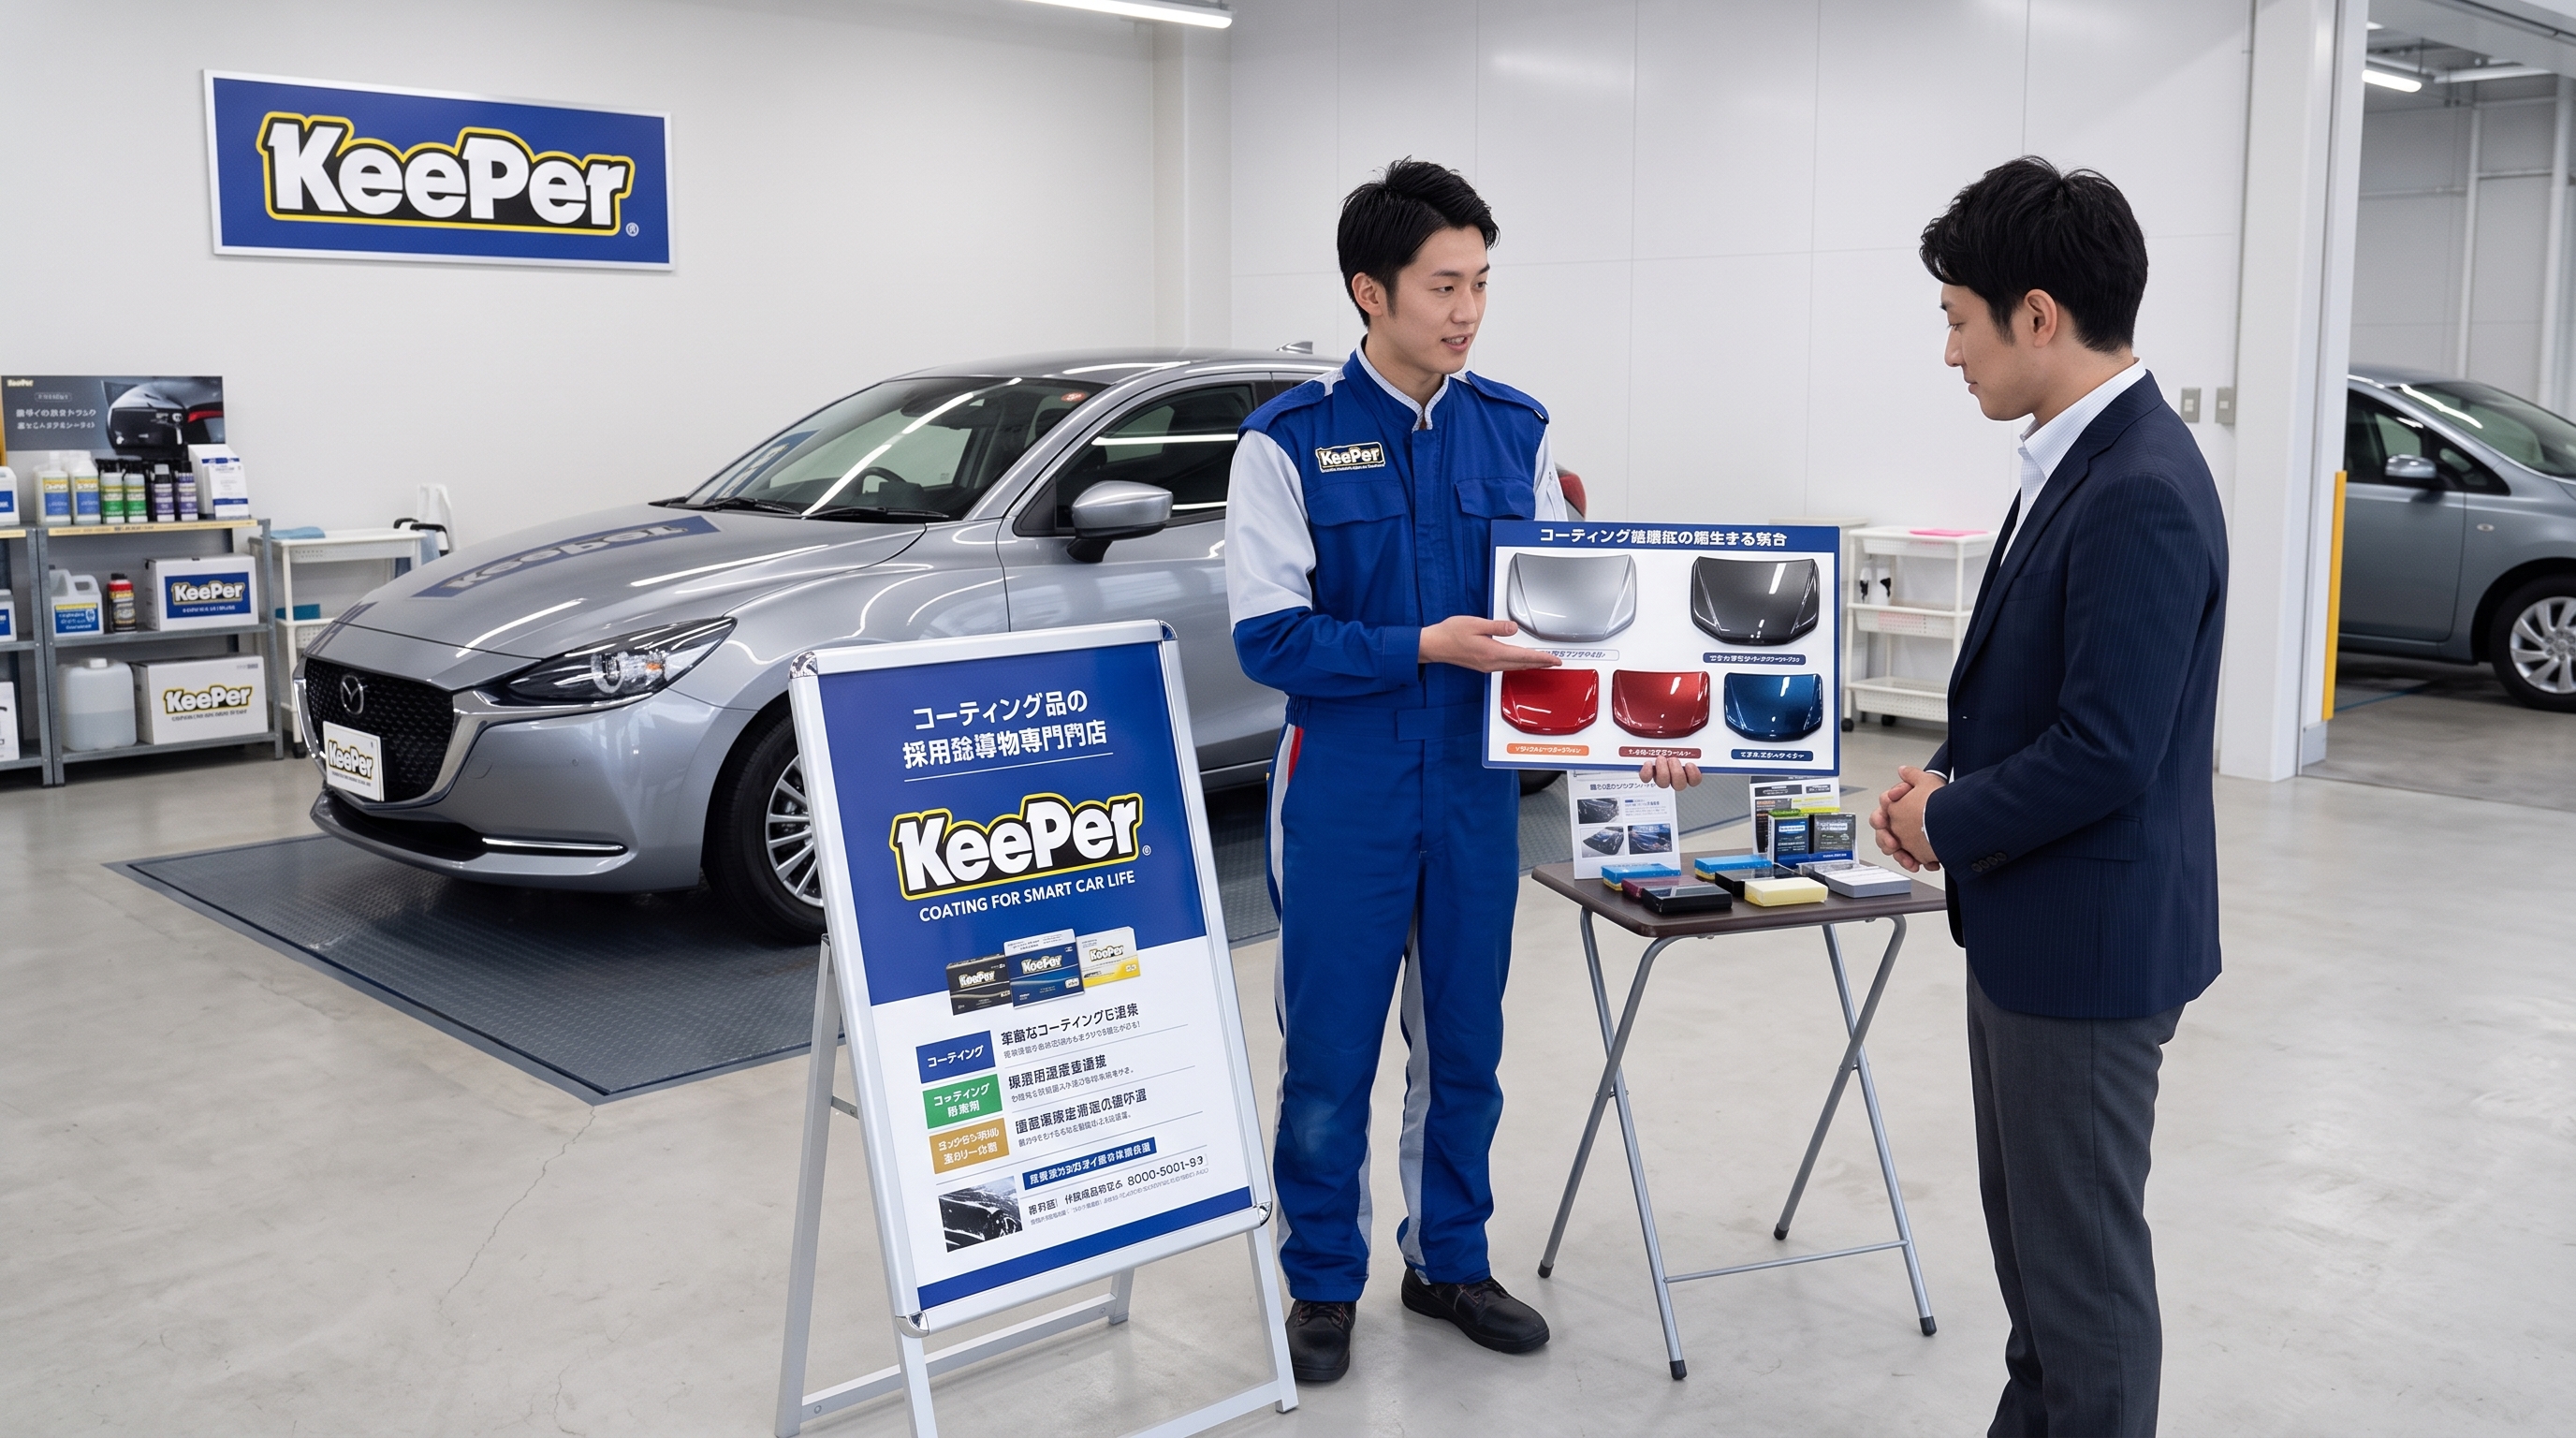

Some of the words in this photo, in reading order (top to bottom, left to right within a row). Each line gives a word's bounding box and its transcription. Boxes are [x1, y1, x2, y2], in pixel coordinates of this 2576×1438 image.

[262, 118, 631, 231] KeePer
[1319, 446, 1381, 466] KeePer
[172, 581, 245, 605] KeePer
[165, 685, 253, 715] KeePer
[914, 690, 1088, 730] コーティング品の
[328, 741, 373, 779] KeePer
[894, 796, 1140, 896] KeePer
[919, 897, 988, 922] COATING
[991, 892, 1021, 909] FOR
[1024, 882, 1072, 903] SMART
[1076, 876, 1105, 893] CAR
[1107, 871, 1135, 888] LIFE
[927, 1045, 984, 1068] コーティング
